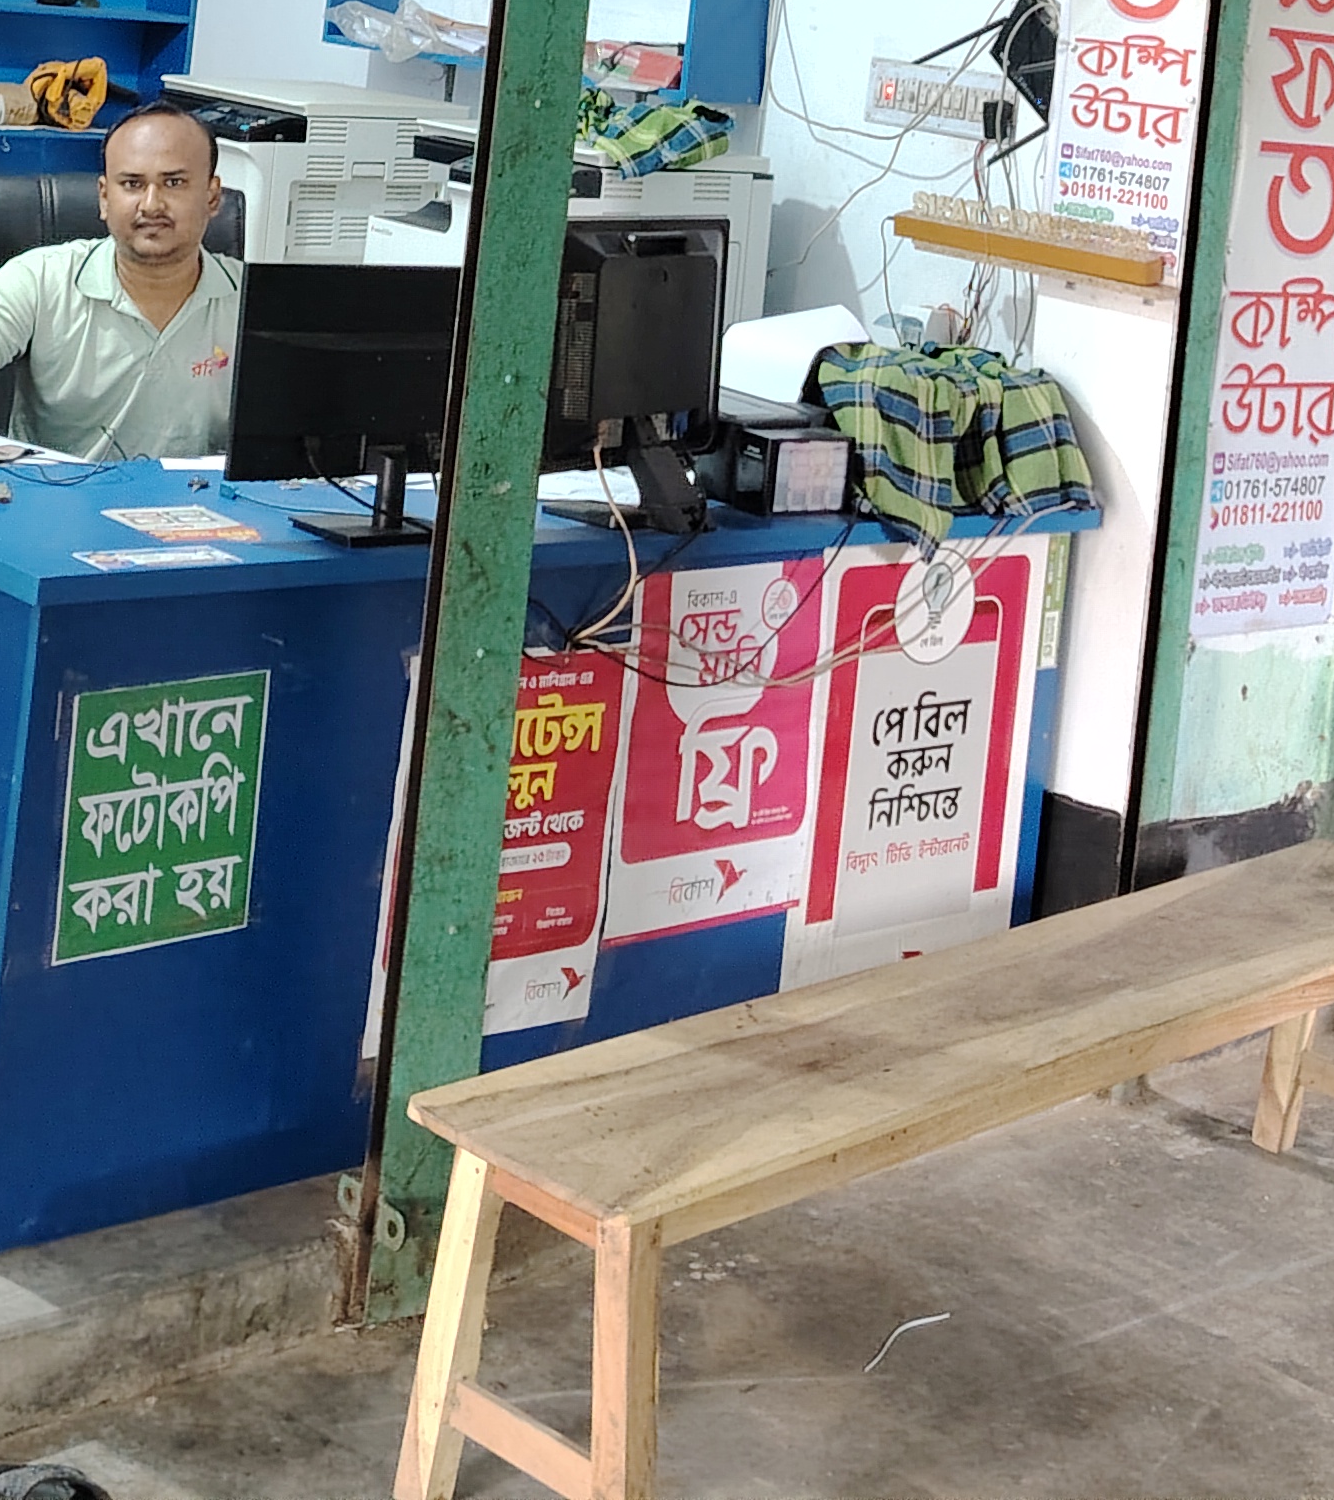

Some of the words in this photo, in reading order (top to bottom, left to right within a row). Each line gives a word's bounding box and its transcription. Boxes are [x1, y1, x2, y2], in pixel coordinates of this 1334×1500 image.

[1069, 84, 1190, 148] উটার
[1070, 181, 1169, 211] 01811-221100
[1072, 164, 1170, 192] 01761-574807
[1223, 476, 1326, 501] 01761-574807
[1221, 500, 1323, 527] 01811-221100
[679, 608, 742, 649] সেন্ড
[85, 695, 255, 765] এখানে
[873, 705, 909, 748] পে
[914, 691, 973, 742] বিল
[675, 697, 779, 830] ফ্রি
[886, 743, 954, 781] করুন
[78, 751, 246, 859] ফটোকপি
[507, 761, 558, 811] লুন
[868, 783, 963, 832] নিশ্চিন্তে
[503, 809, 543, 839] জন্ট
[543, 809, 585, 836] থেকে
[885, 841, 912, 866] টিভি
[917, 833, 971, 859] ইন্টারনেট
[68, 862, 165, 934] করা
[172, 854, 243, 920] হয়
